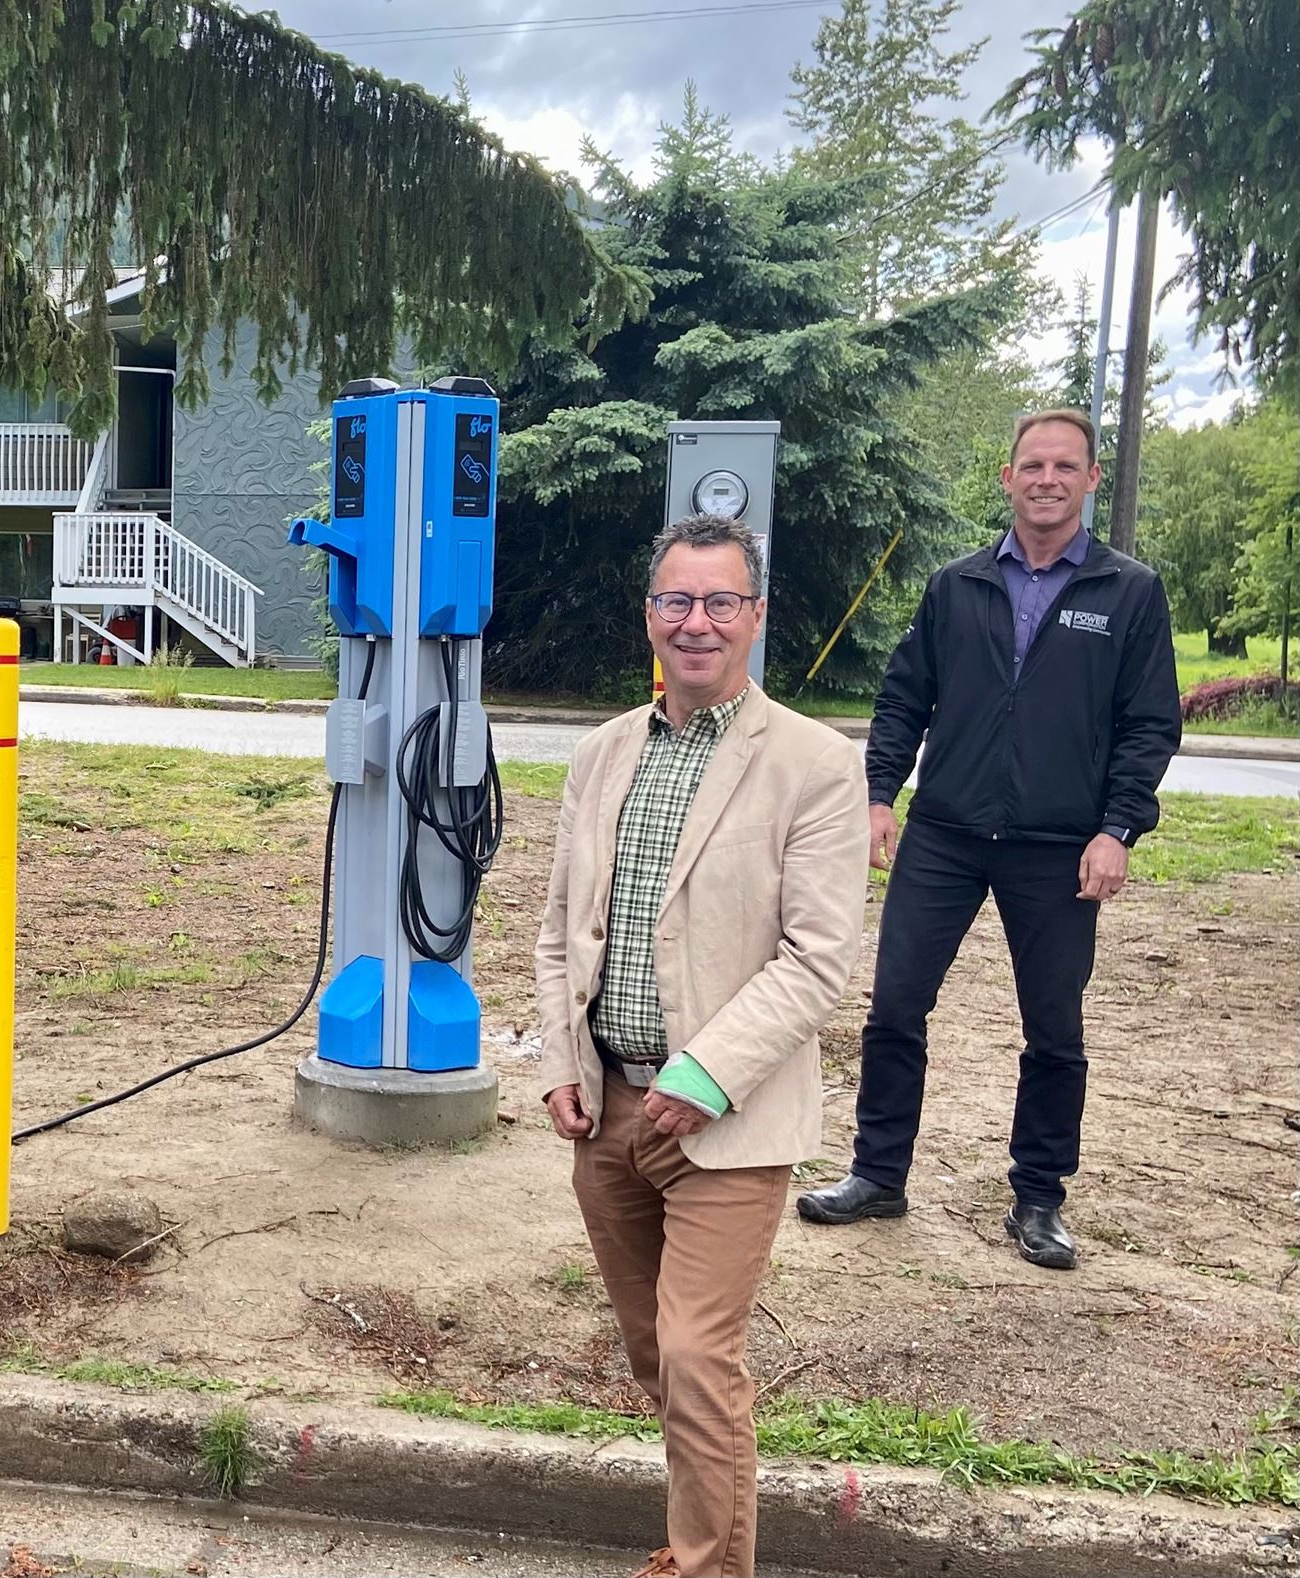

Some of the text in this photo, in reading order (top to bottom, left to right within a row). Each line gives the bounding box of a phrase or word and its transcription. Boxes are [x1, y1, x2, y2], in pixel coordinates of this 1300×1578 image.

[350, 417, 367, 438] flo
[470, 416, 492, 437] flo
[1074, 613, 1108, 626] POWER
